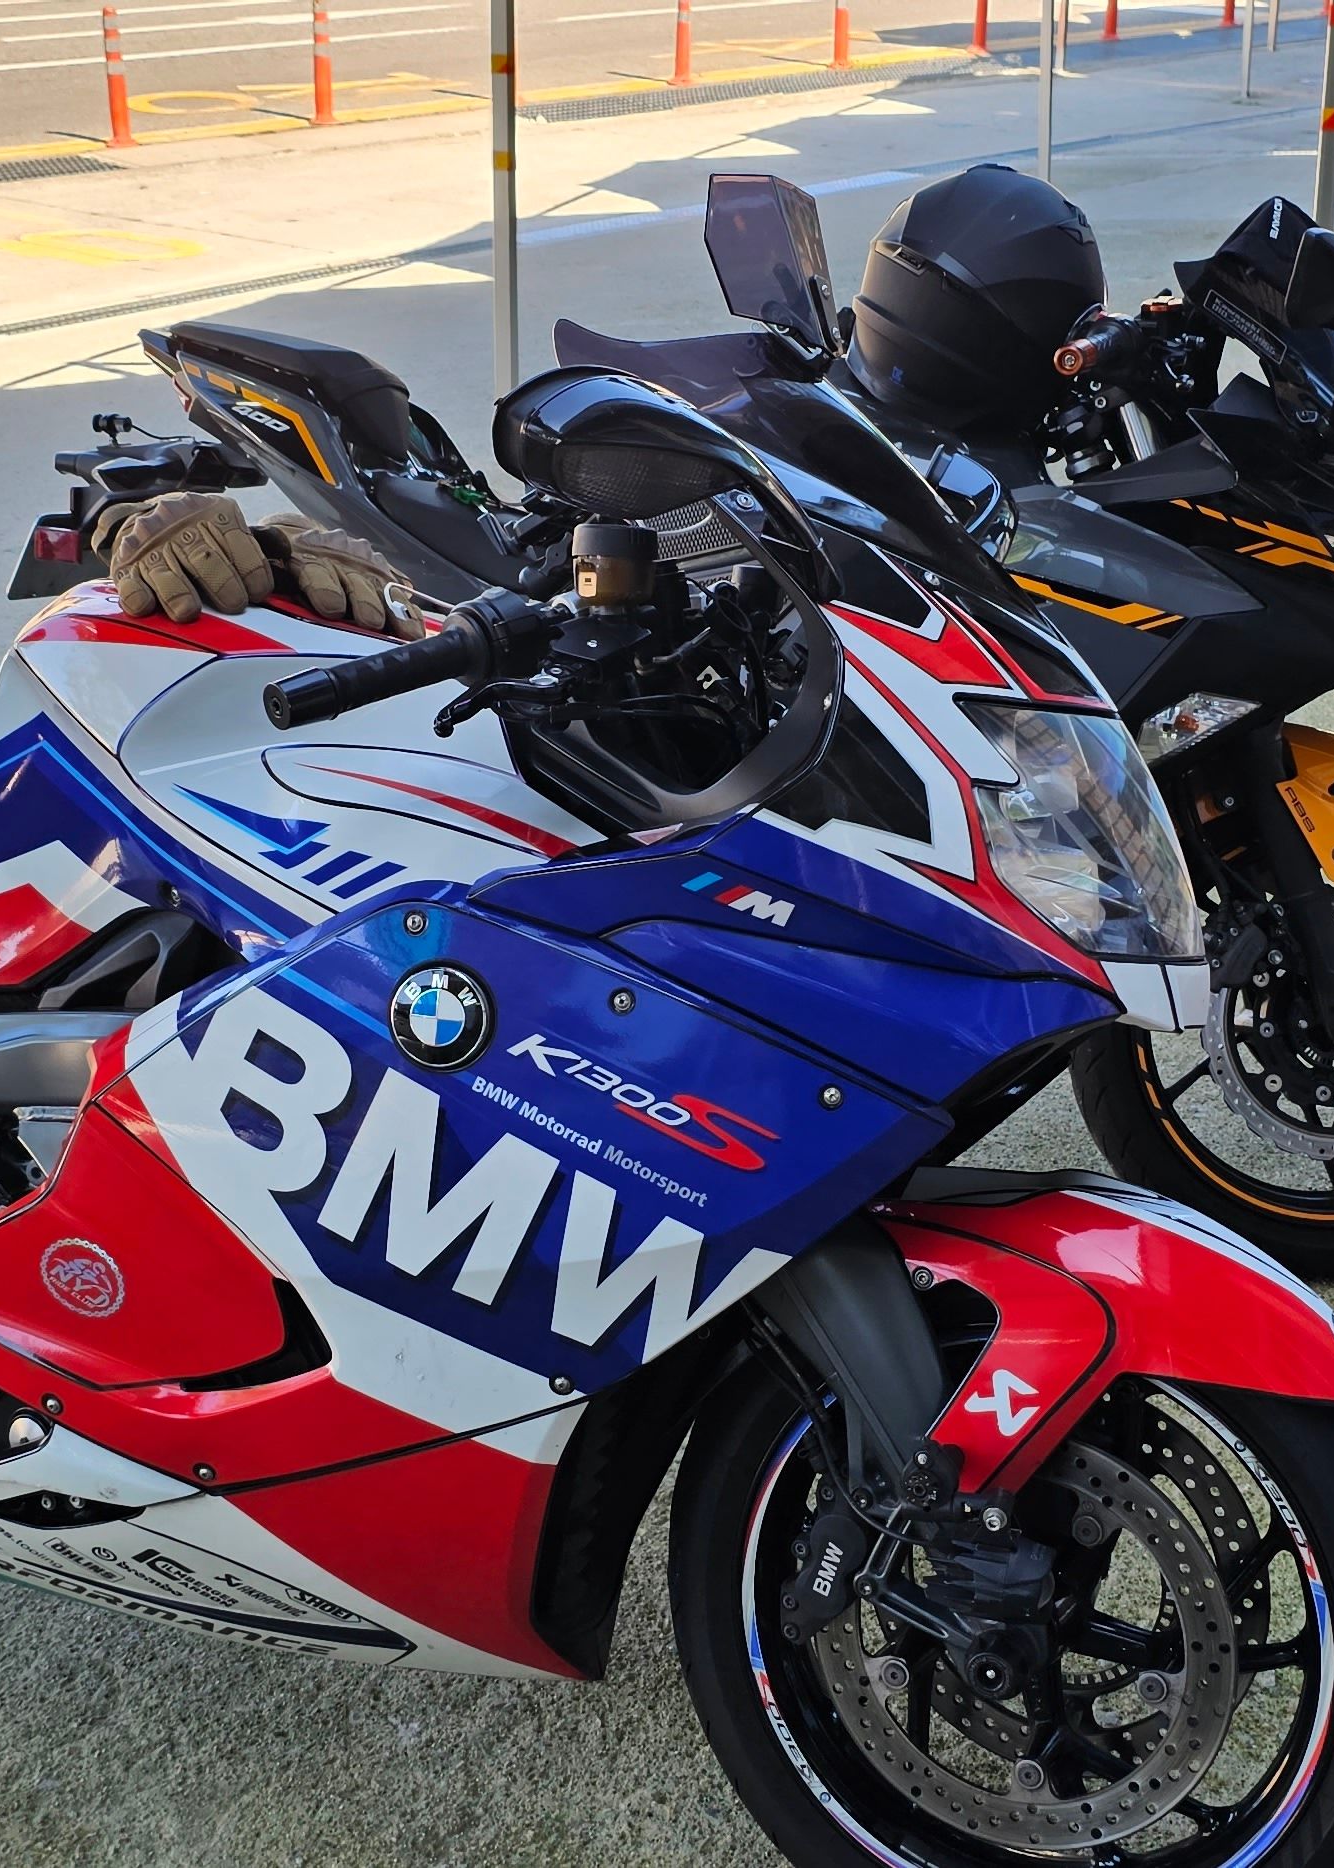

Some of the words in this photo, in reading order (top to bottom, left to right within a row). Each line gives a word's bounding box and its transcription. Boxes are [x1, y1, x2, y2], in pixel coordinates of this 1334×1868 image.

[231, 402, 291, 432] 400
[1285, 786, 1316, 833] ABS
[404, 973, 477, 1007] BMW
[506, 1033, 781, 1171] K1300S
[471, 1075, 519, 1111] BMW
[518, 1101, 603, 1155] Motorrad
[603, 1144, 708, 1208] Motorsport
[172, 984, 793, 1366] BMW
[50, 1540, 116, 1580] ÖHLINS
[116, 1561, 184, 1597] brembo
[812, 1541, 844, 1597] BMW
[293, 1589, 354, 1621] SHOEI
